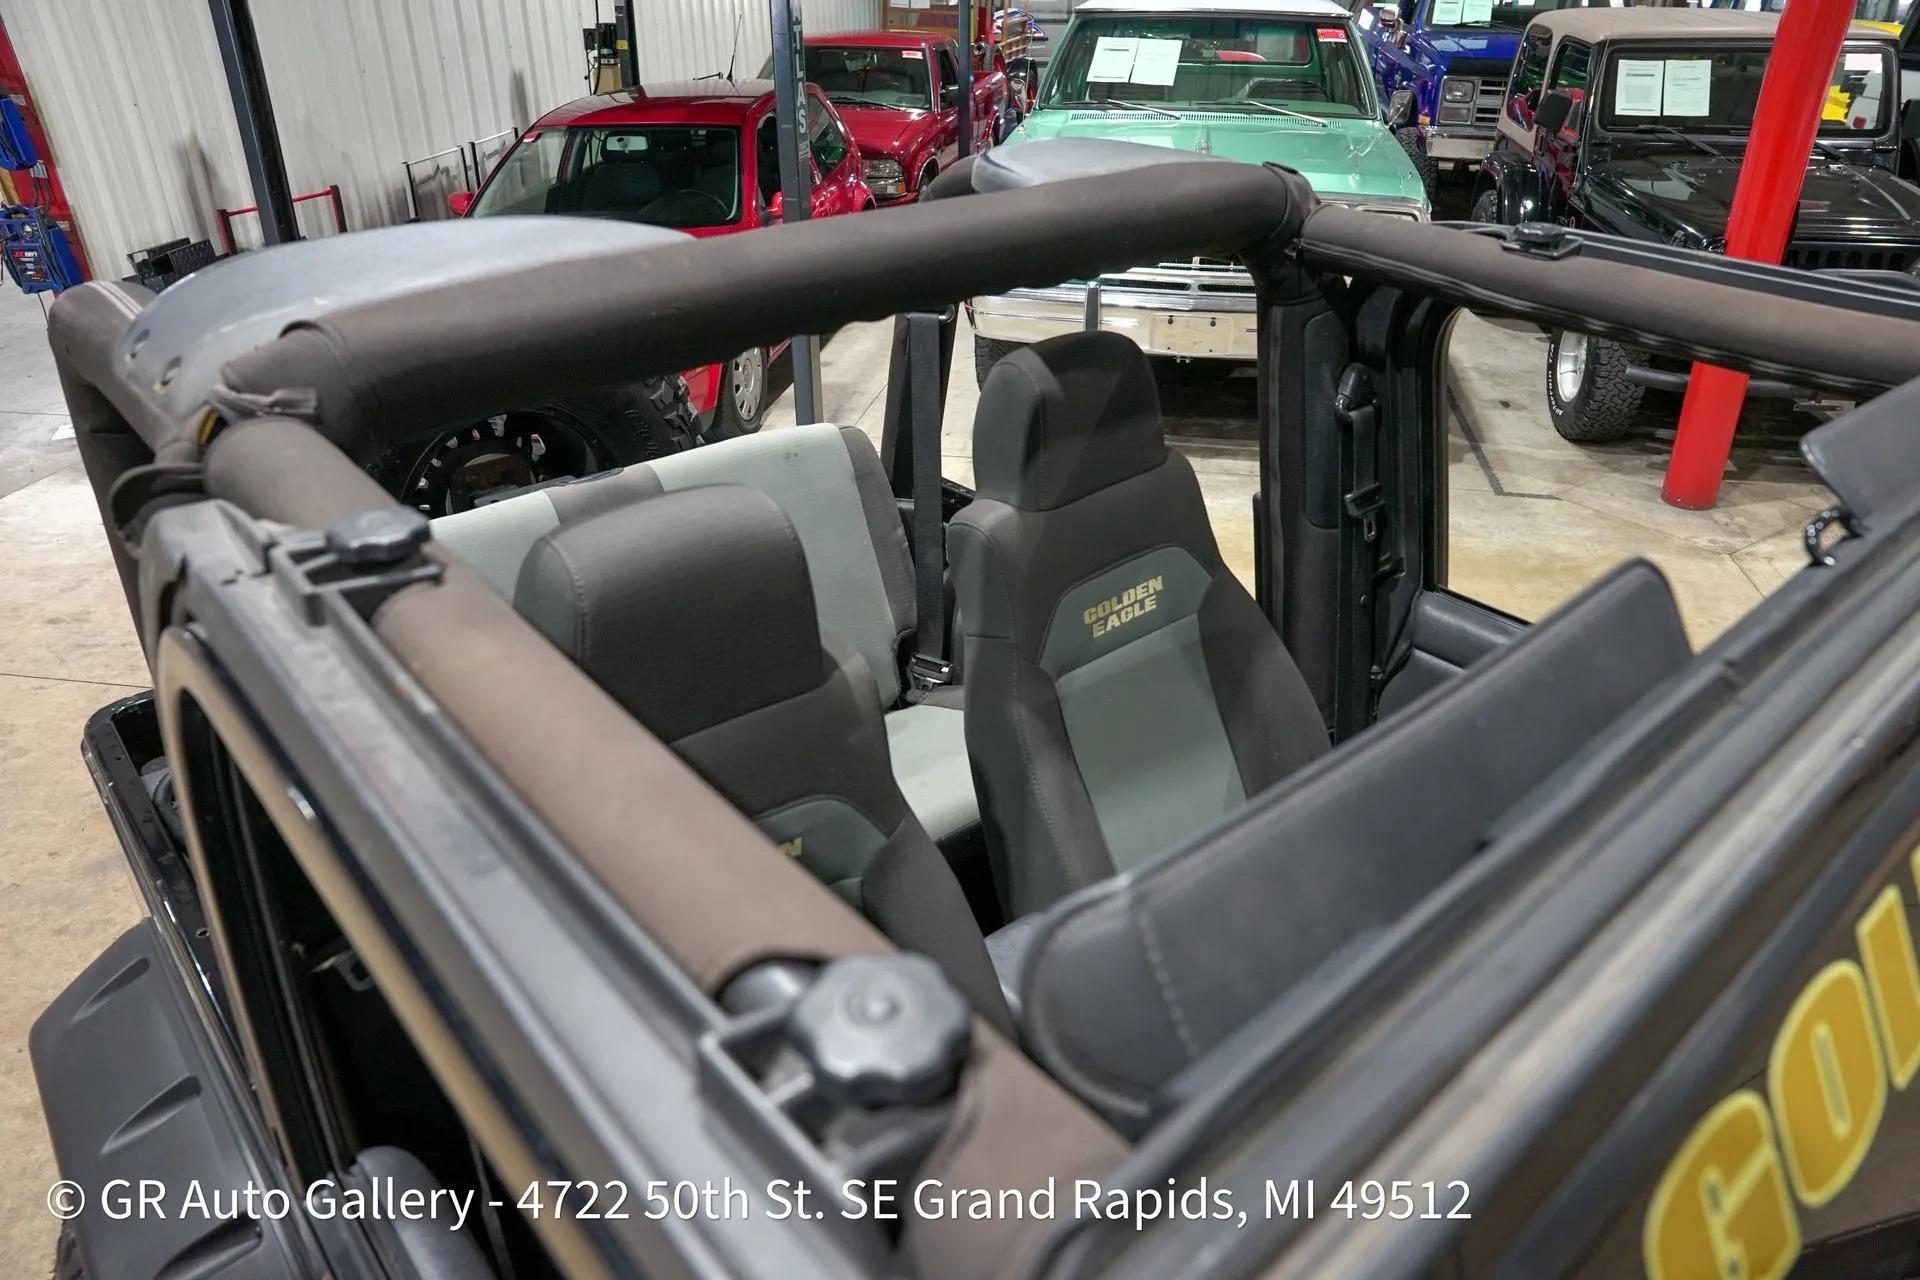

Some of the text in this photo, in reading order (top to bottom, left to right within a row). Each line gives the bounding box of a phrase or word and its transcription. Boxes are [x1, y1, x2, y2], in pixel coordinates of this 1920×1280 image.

[791, 0, 807, 134] ATLAS
[1083, 575, 1164, 625] GOLDEN
[1092, 595, 1158, 639] EAGLE
[1643, 843, 1920, 1280] GOL
